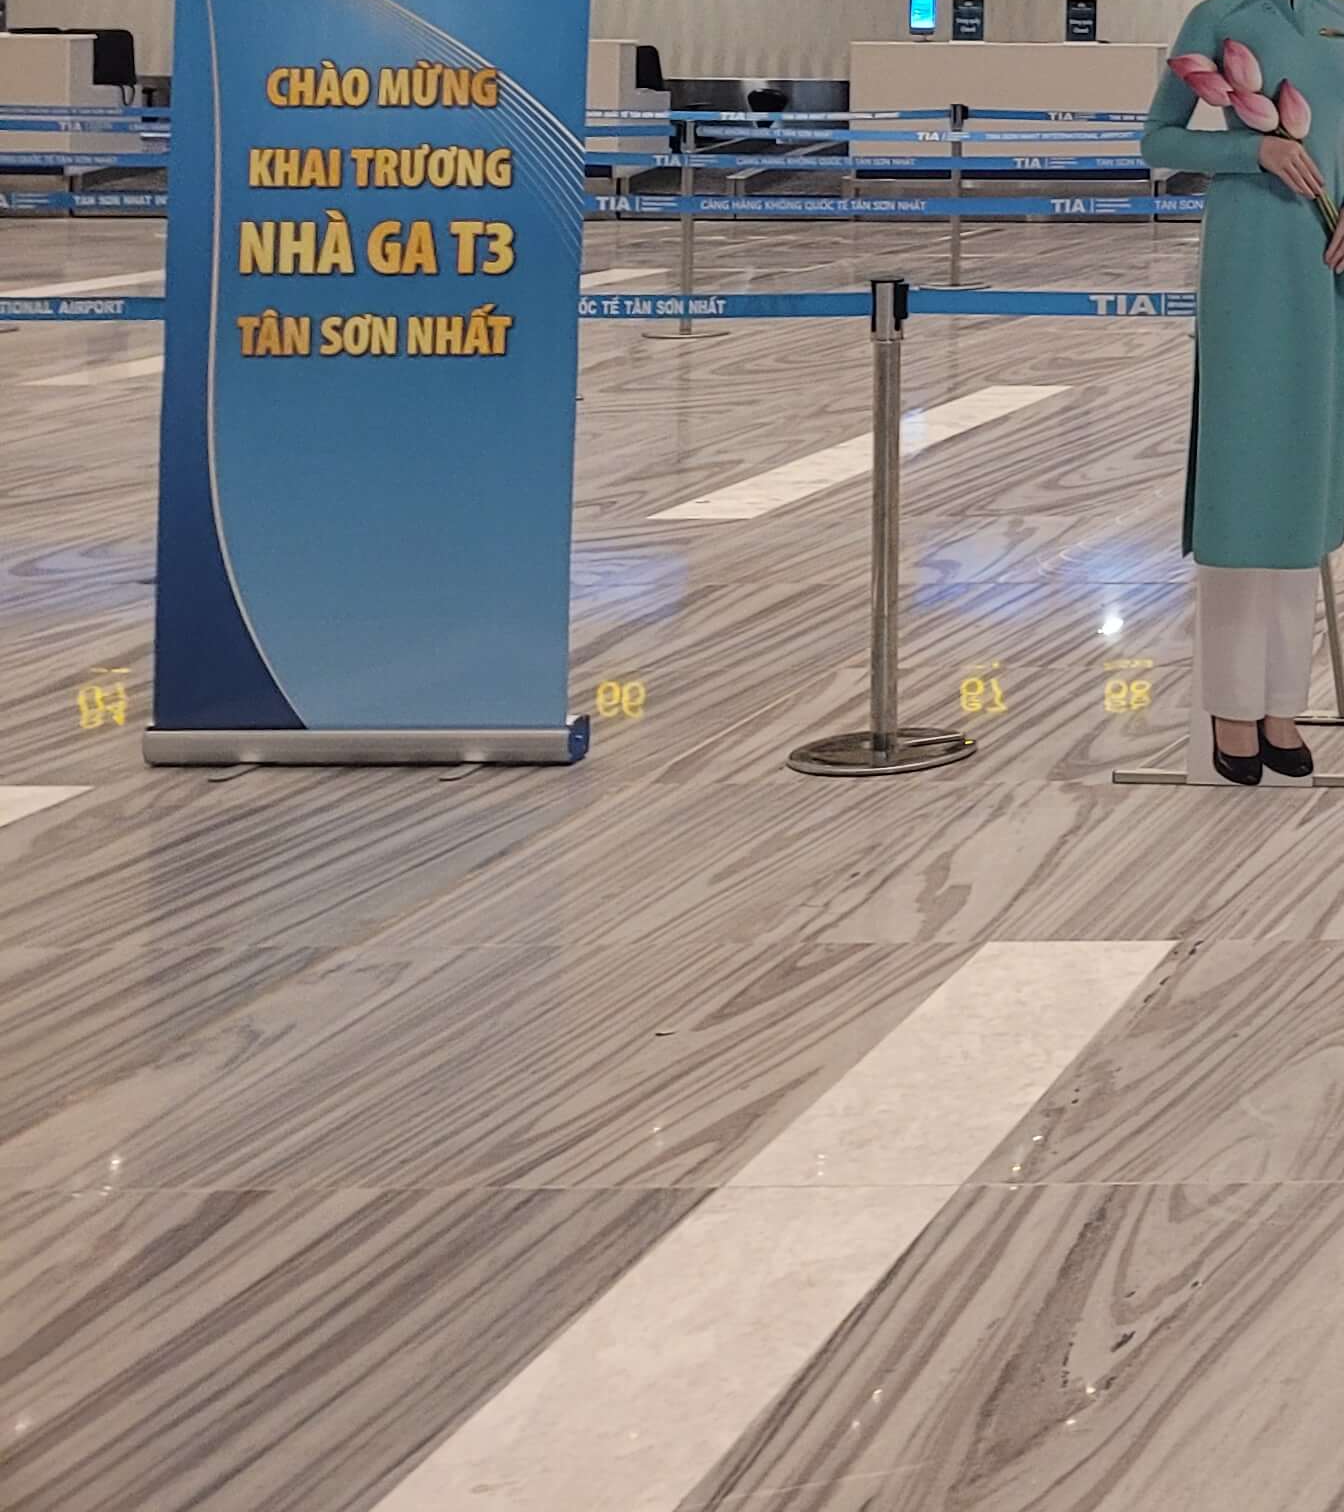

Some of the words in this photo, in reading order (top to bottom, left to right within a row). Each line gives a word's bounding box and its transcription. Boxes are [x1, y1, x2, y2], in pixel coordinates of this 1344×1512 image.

[266, 60, 370, 107] CHÀO
[378, 59, 498, 107] MỪNG
[1048, 113, 1073, 121] TIA
[916, 132, 941, 141] TIA
[249, 148, 341, 187] KHAI
[351, 144, 511, 187] TRƯƠNG
[652, 155, 682, 167] TIA
[1013, 157, 1042, 169] TIA
[595, 196, 631, 211] TIA
[1051, 199, 1086, 213] TIA
[1154, 200, 1175, 210] TAN
[1177, 200, 1203, 210] SON
[239, 209, 355, 275] NHÀ
[367, 221, 438, 275] GA
[450, 221, 514, 275] T3
[59, 299, 125, 315] AIRPORT
[578, 296, 598, 315] ỐC
[602, 296, 621, 315] TẾ
[624, 297, 652, 315] TÂN
[656, 298, 684, 315] SƠN
[688, 296, 727, 315] NHẤT
[1088, 294, 1158, 316] TIA
[237, 309, 310, 355] TÂN
[320, 314, 398, 355] SƠN
[407, 303, 512, 355] NHẤT
